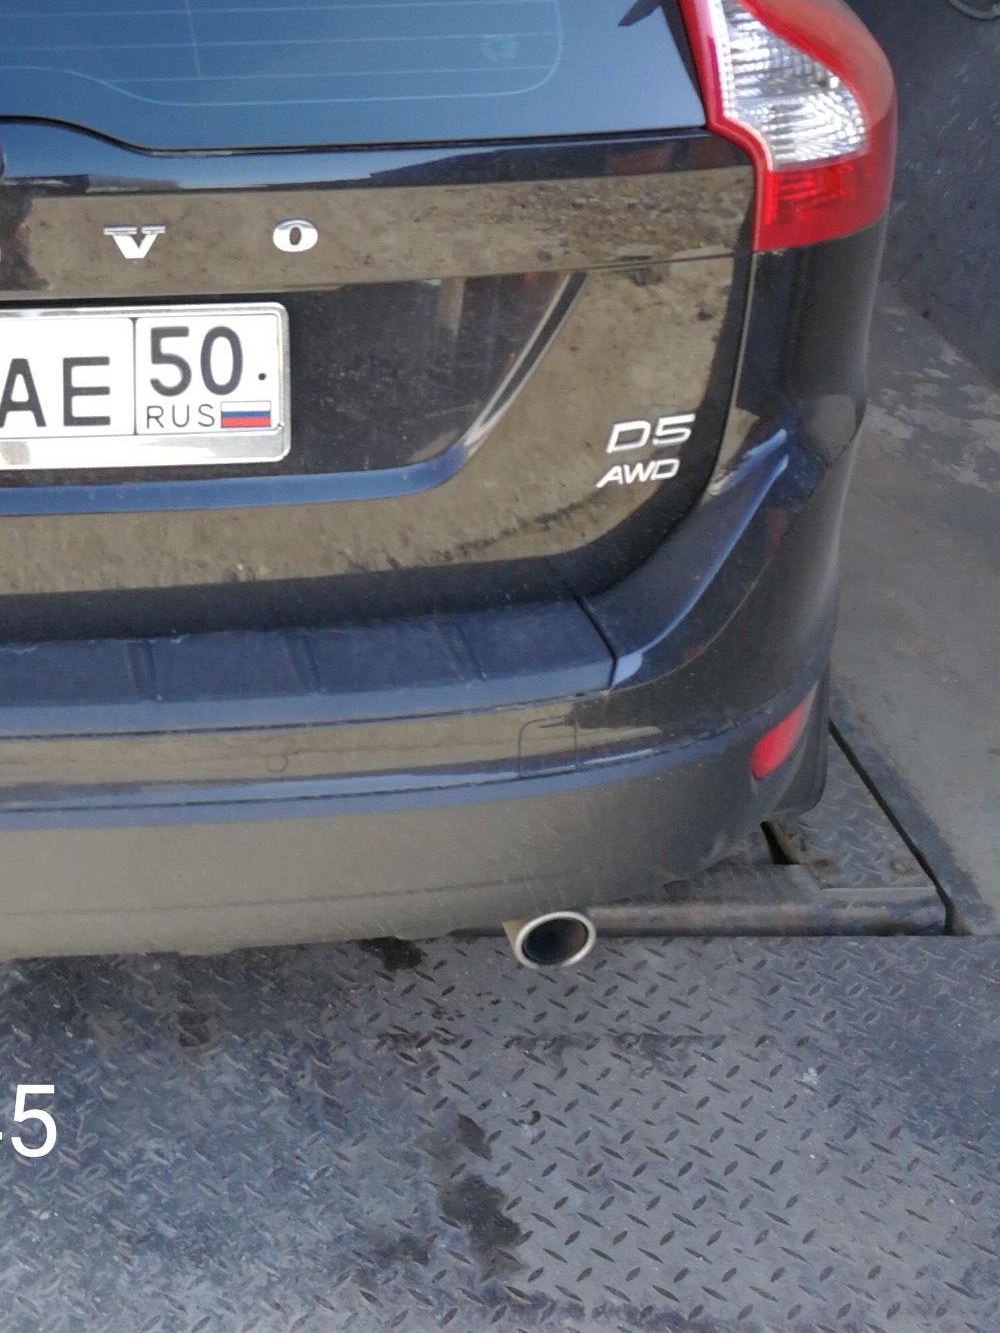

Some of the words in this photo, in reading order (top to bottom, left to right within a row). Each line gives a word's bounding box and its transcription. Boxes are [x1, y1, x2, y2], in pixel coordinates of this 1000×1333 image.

[149, 326, 243, 397] 50
[146, 404, 215, 430] RUS
[606, 414, 696, 454] D5
[594, 458, 680, 489] AWD
